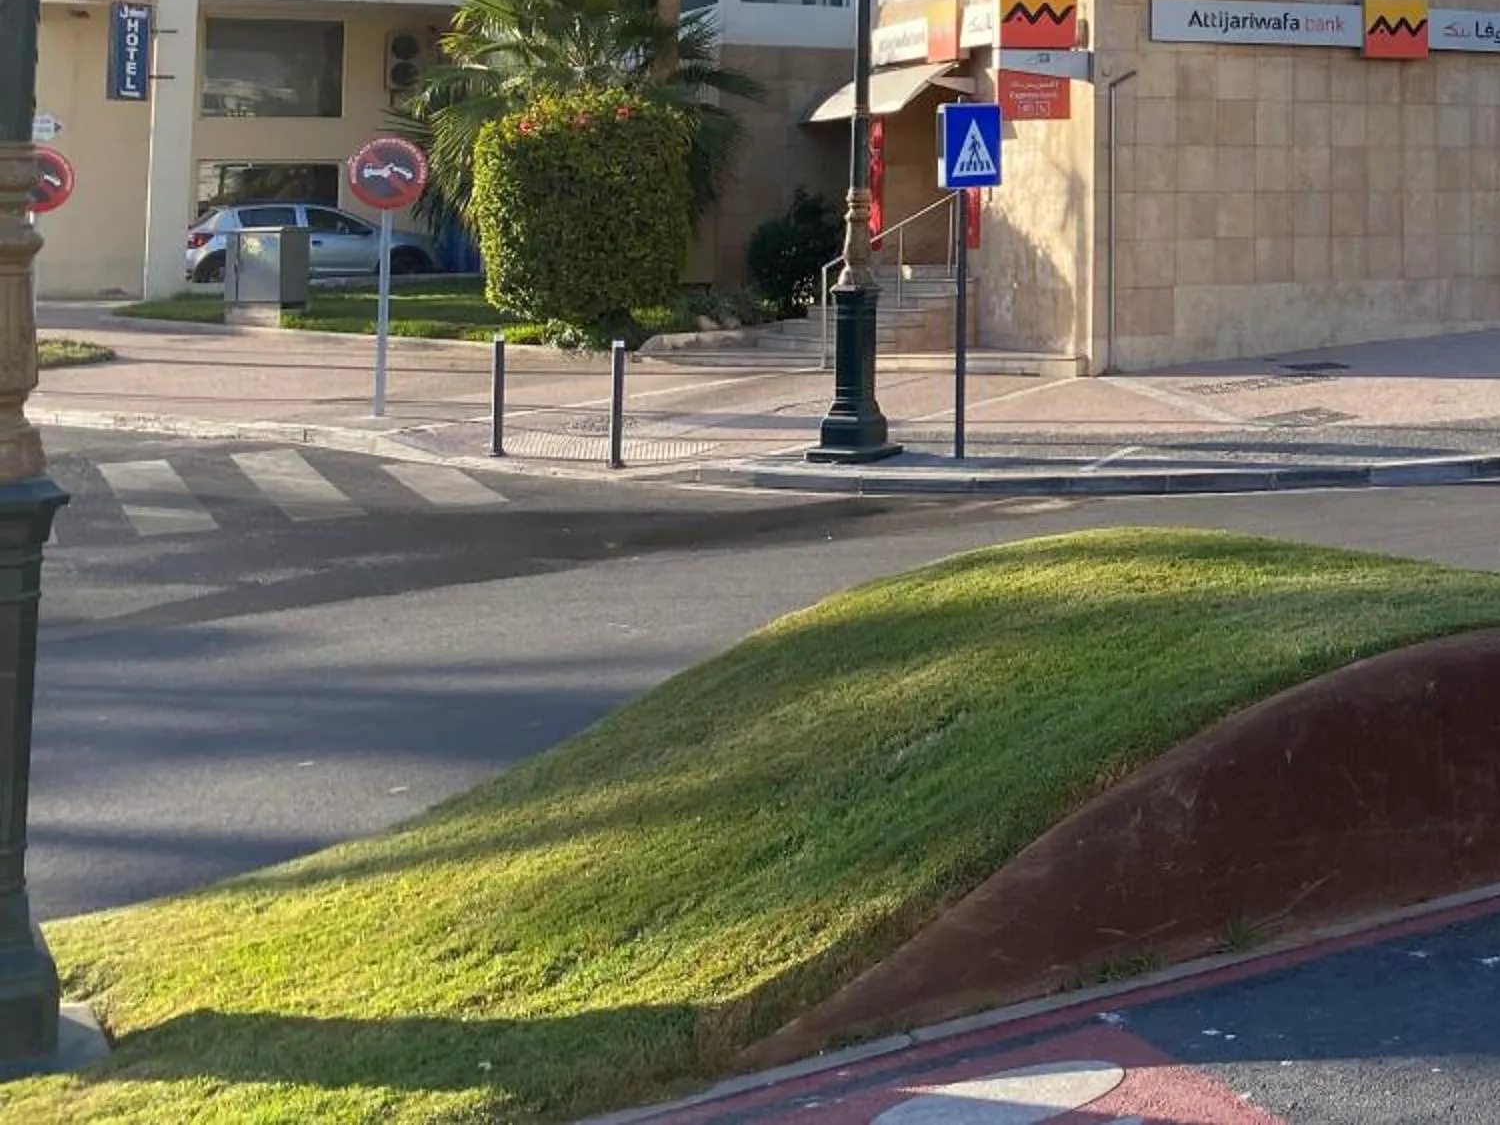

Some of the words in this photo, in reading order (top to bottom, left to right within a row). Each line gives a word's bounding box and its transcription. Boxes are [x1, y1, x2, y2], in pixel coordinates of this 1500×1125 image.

[1187, 10, 1300, 33] Attijariwafa
[1304, 15, 1345, 32] bank
[126, 19, 139, 90] HOTEL
